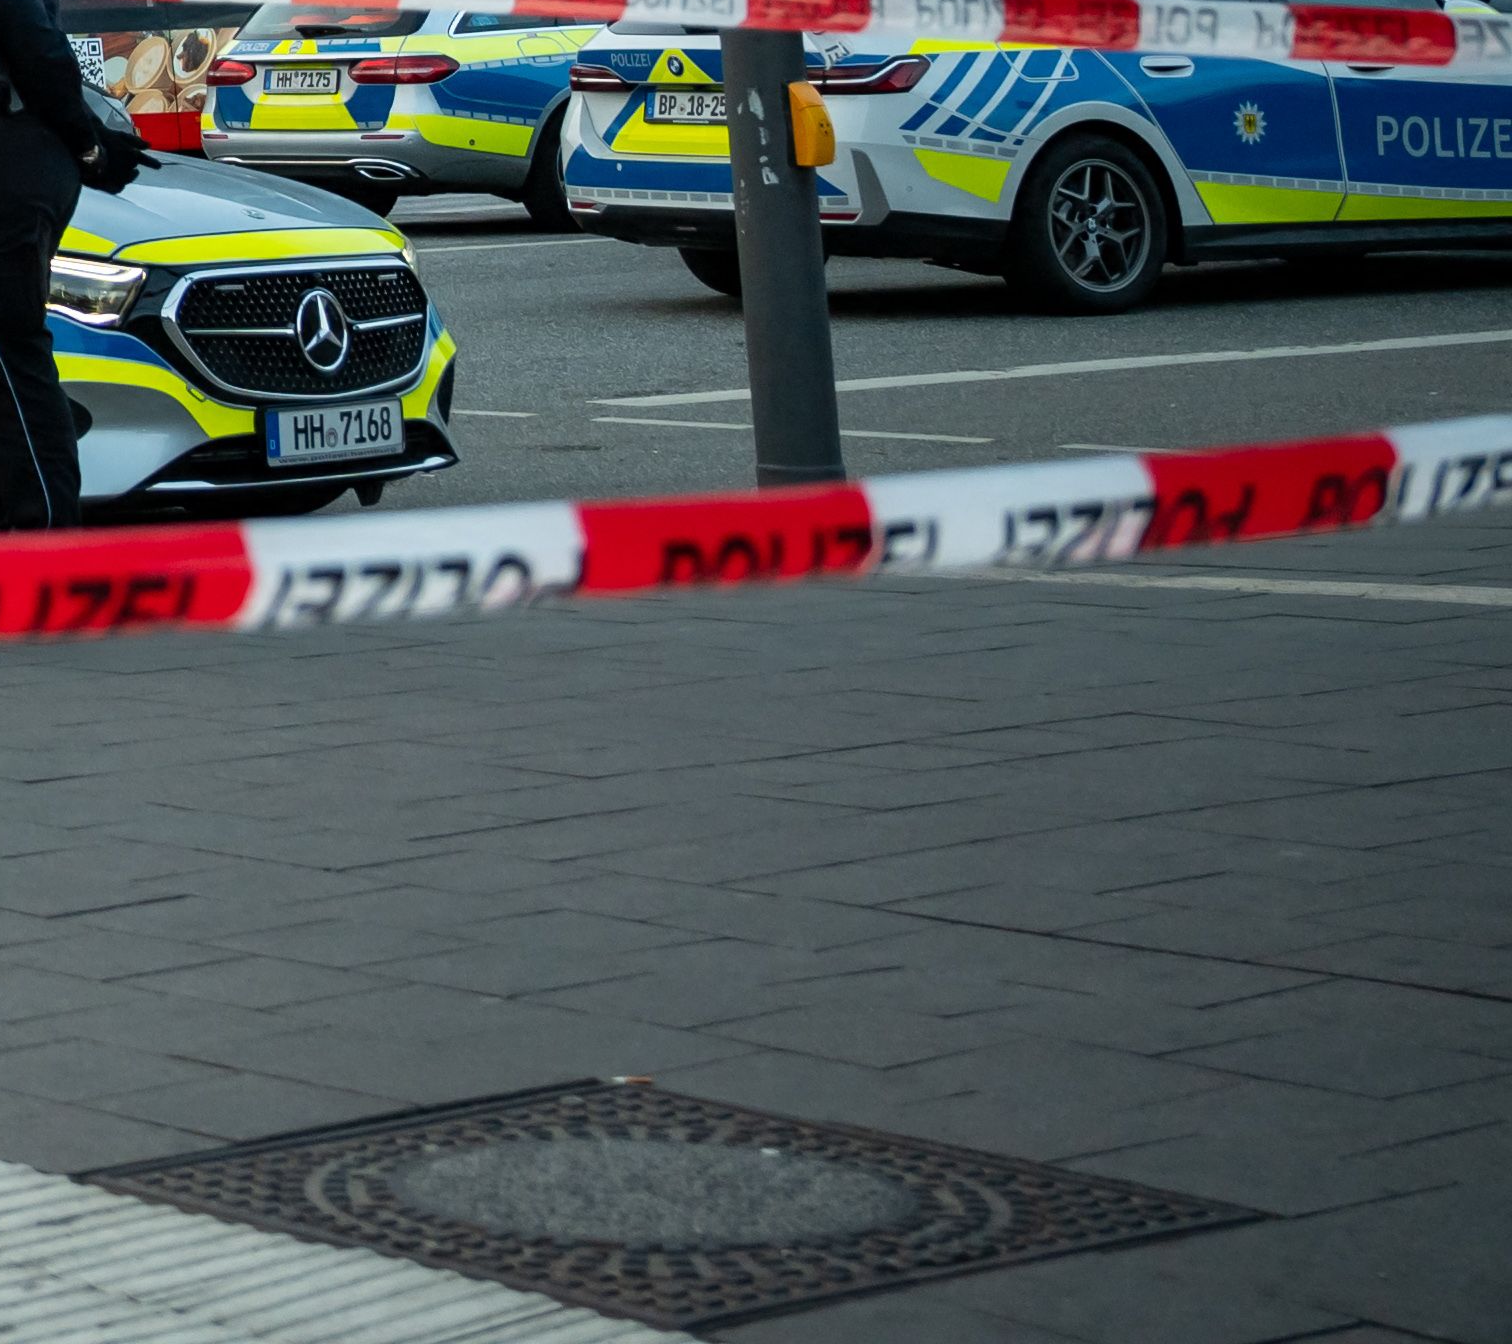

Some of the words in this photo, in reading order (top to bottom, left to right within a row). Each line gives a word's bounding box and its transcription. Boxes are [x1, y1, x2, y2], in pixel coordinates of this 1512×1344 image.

[610, 53, 652, 67] POLIZEI
[276, 72, 292, 88] HH
[300, 72, 331, 88] 7175
[658, 94, 677, 116] BP
[1376, 115, 1512, 158] POLIZE
[293, 414, 325, 450] HH
[340, 406, 392, 446] 7168
